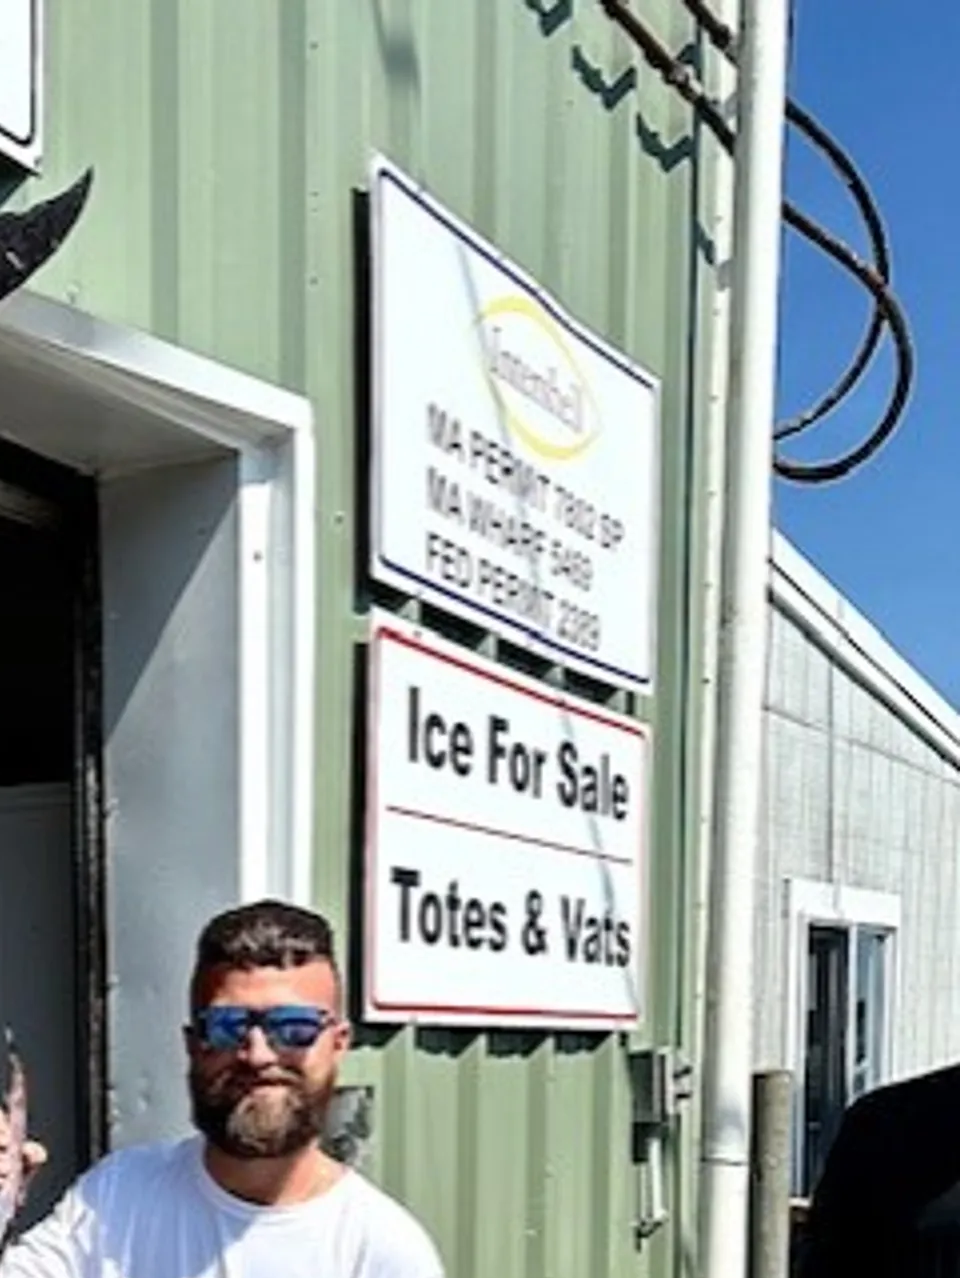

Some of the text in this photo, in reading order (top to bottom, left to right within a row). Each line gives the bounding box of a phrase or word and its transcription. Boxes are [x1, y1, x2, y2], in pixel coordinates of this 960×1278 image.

[428, 402, 465, 464] MA
[470, 430, 550, 512] PERMIT
[428, 466, 465, 526] MA
[426, 531, 473, 589] FED
[478, 557, 554, 628] PERMIT
[408, 686, 629, 821] Ice For Sale
[390, 866, 631, 968] Totes & Vats
